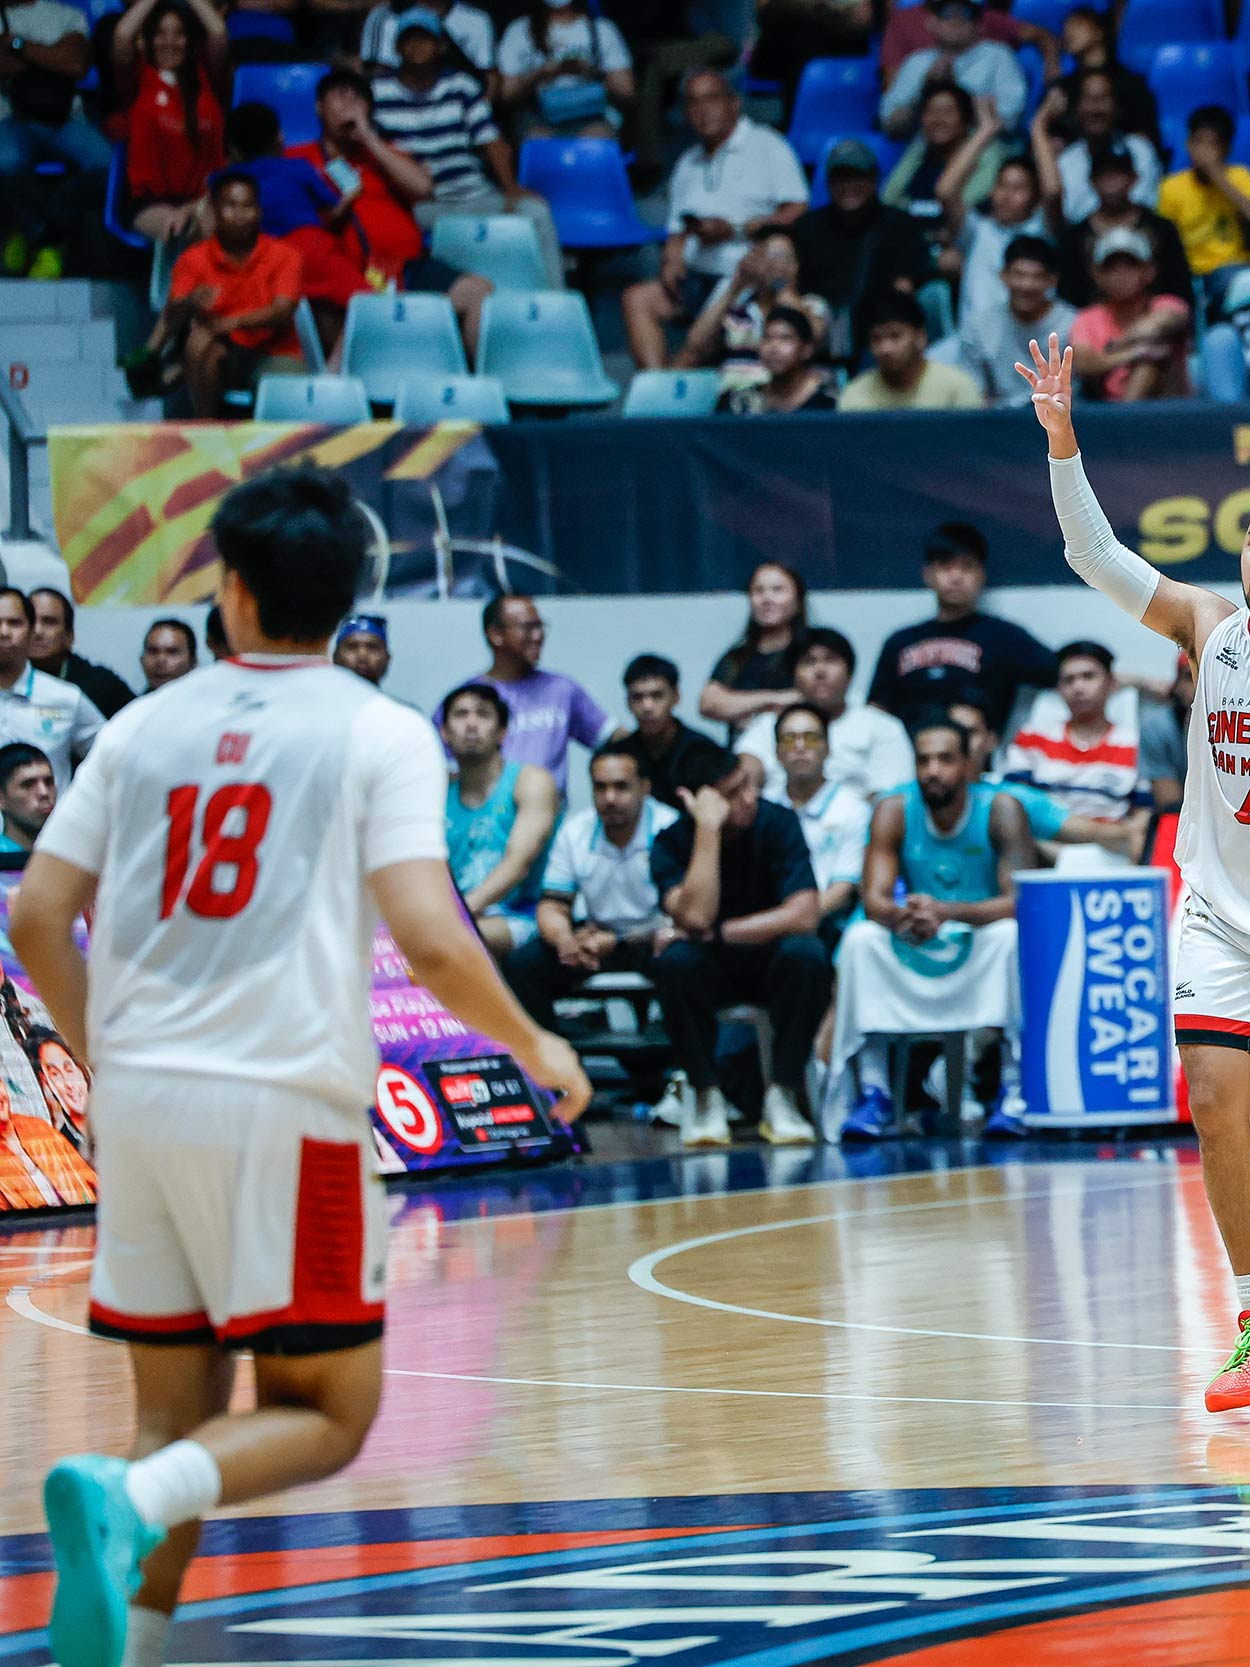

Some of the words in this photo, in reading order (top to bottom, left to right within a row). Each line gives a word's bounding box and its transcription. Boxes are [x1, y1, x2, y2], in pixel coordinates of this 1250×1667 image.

[160, 783, 273, 921] 18
[1085, 888, 1129, 1085] SWEAT
[1122, 887, 1161, 1103] POCARI
[385, 1080, 427, 1136] 5
